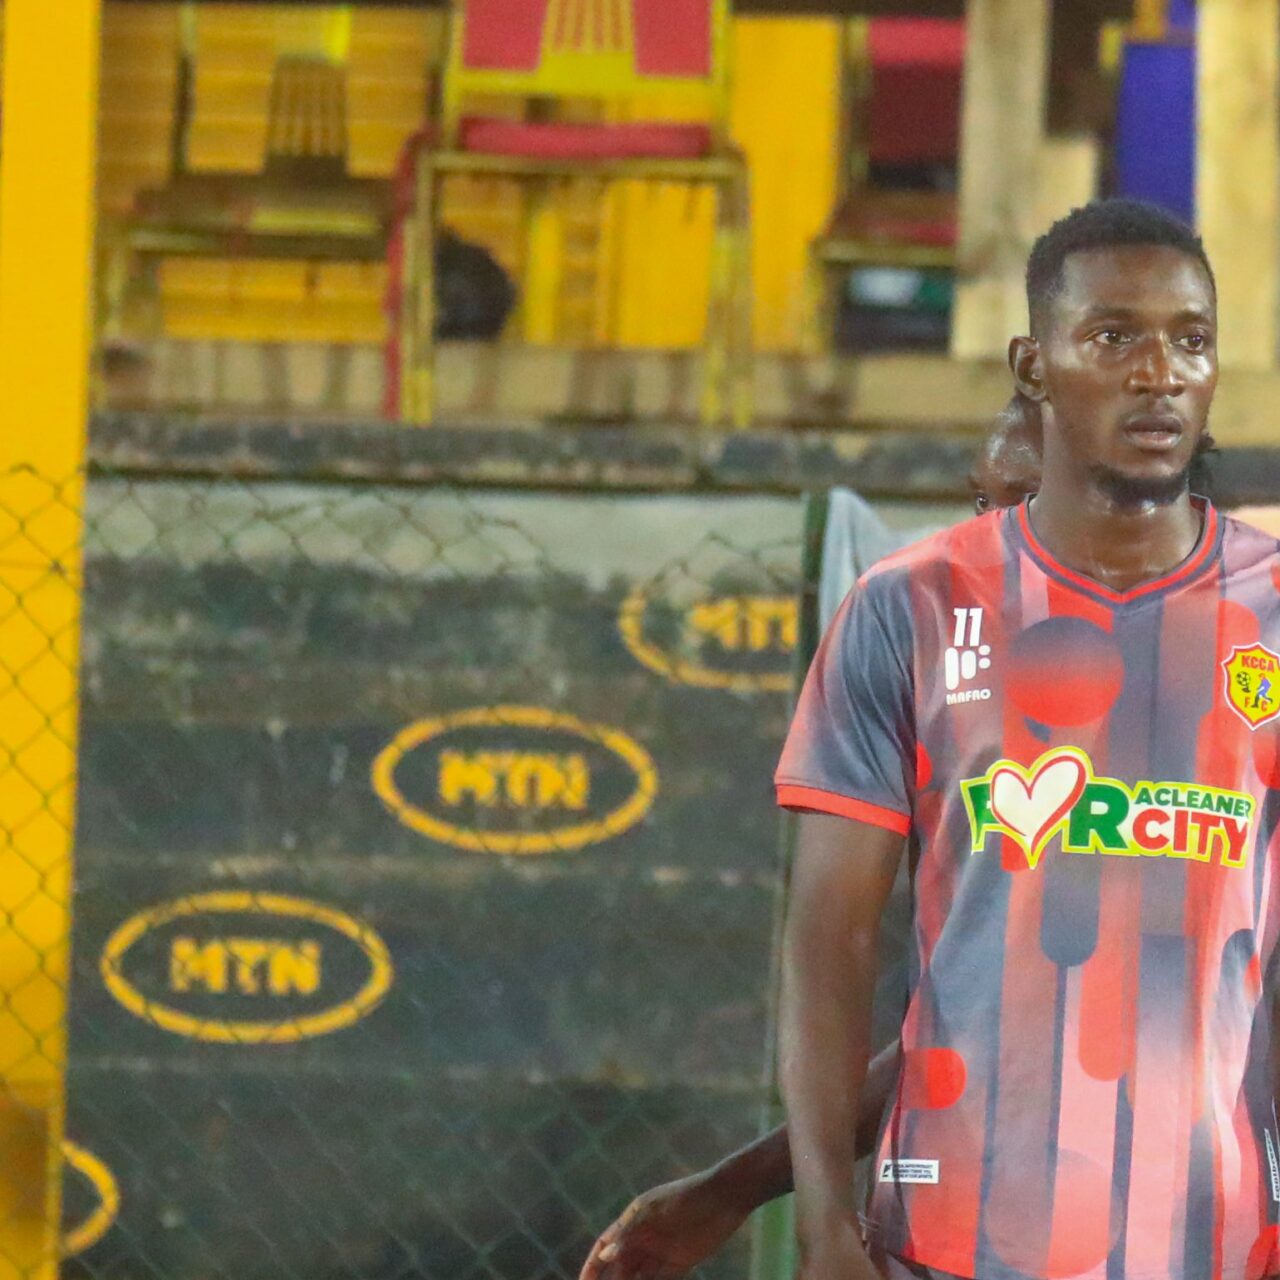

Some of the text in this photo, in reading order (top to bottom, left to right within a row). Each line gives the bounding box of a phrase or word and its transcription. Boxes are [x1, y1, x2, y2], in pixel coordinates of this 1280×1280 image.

[953, 607, 984, 648] 11
[1241, 654, 1275, 673] KCCA
[438, 749, 590, 811] MTN
[1132, 808, 1249, 862] CITY
[170, 937, 322, 995] MTN
